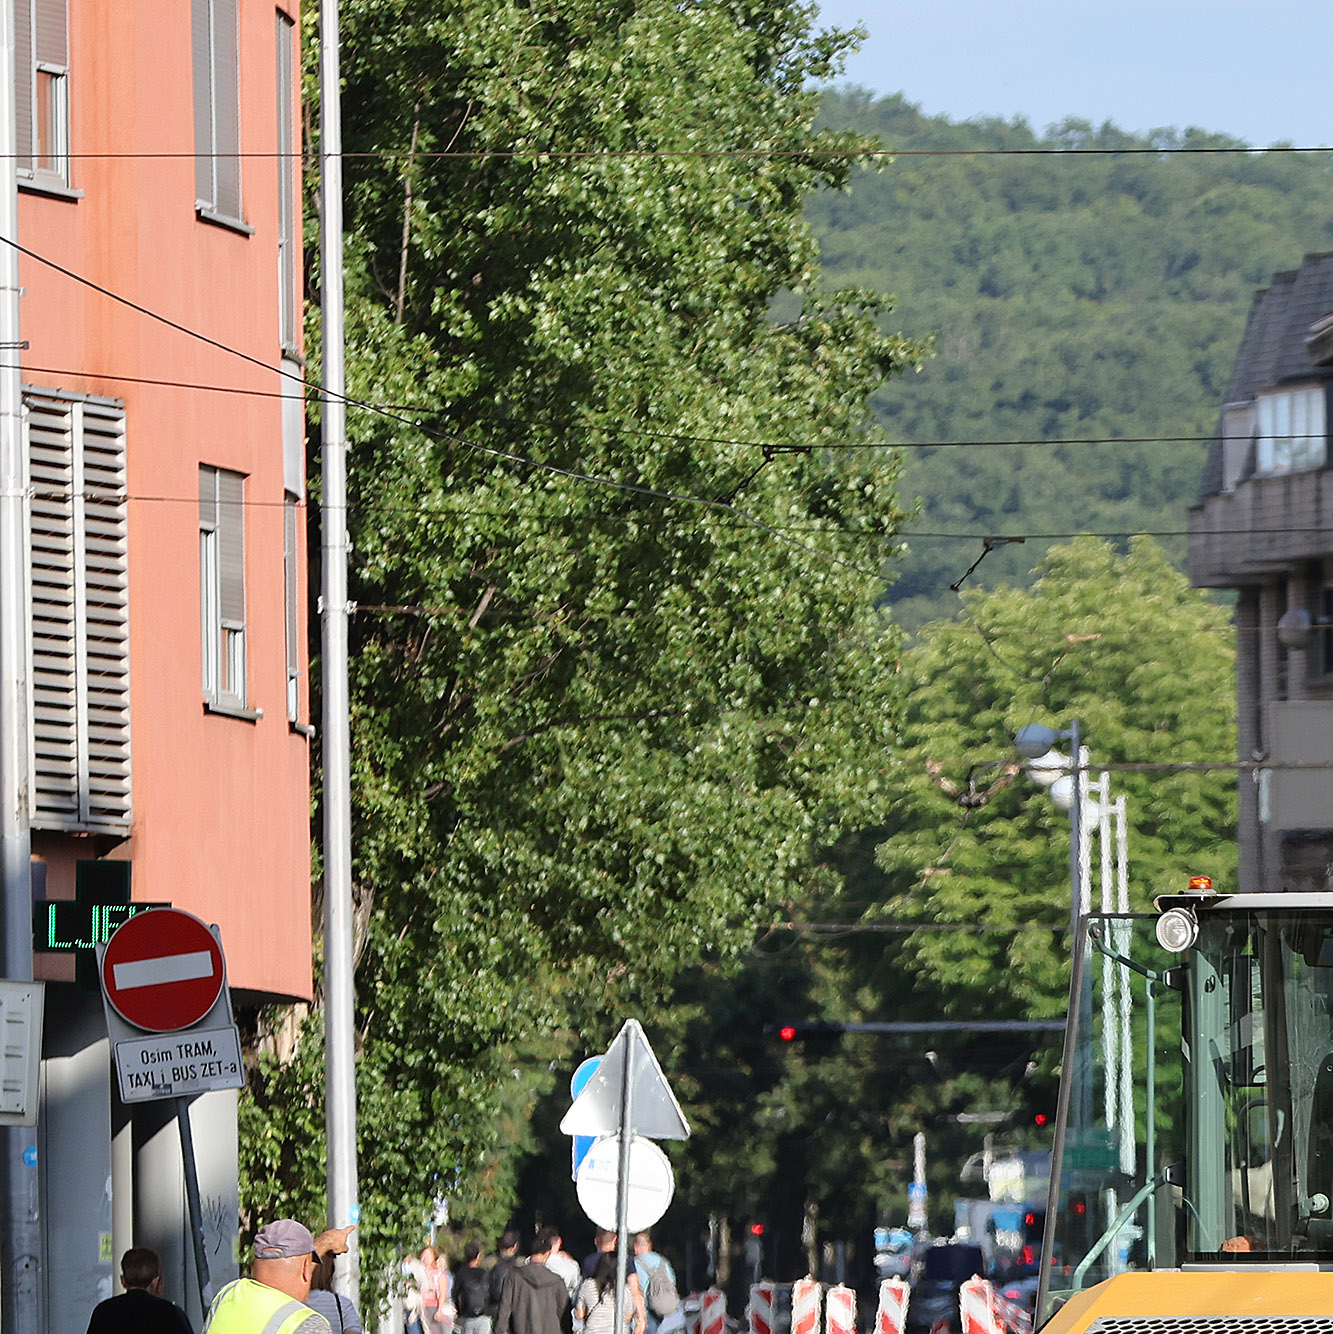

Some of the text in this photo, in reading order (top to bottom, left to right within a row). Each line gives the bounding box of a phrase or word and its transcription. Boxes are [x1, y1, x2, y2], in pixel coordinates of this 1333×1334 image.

[141, 1040, 217, 1065] Osim TRAM,
[128, 1061, 237, 1088] TAXI i BUS ZET-a
